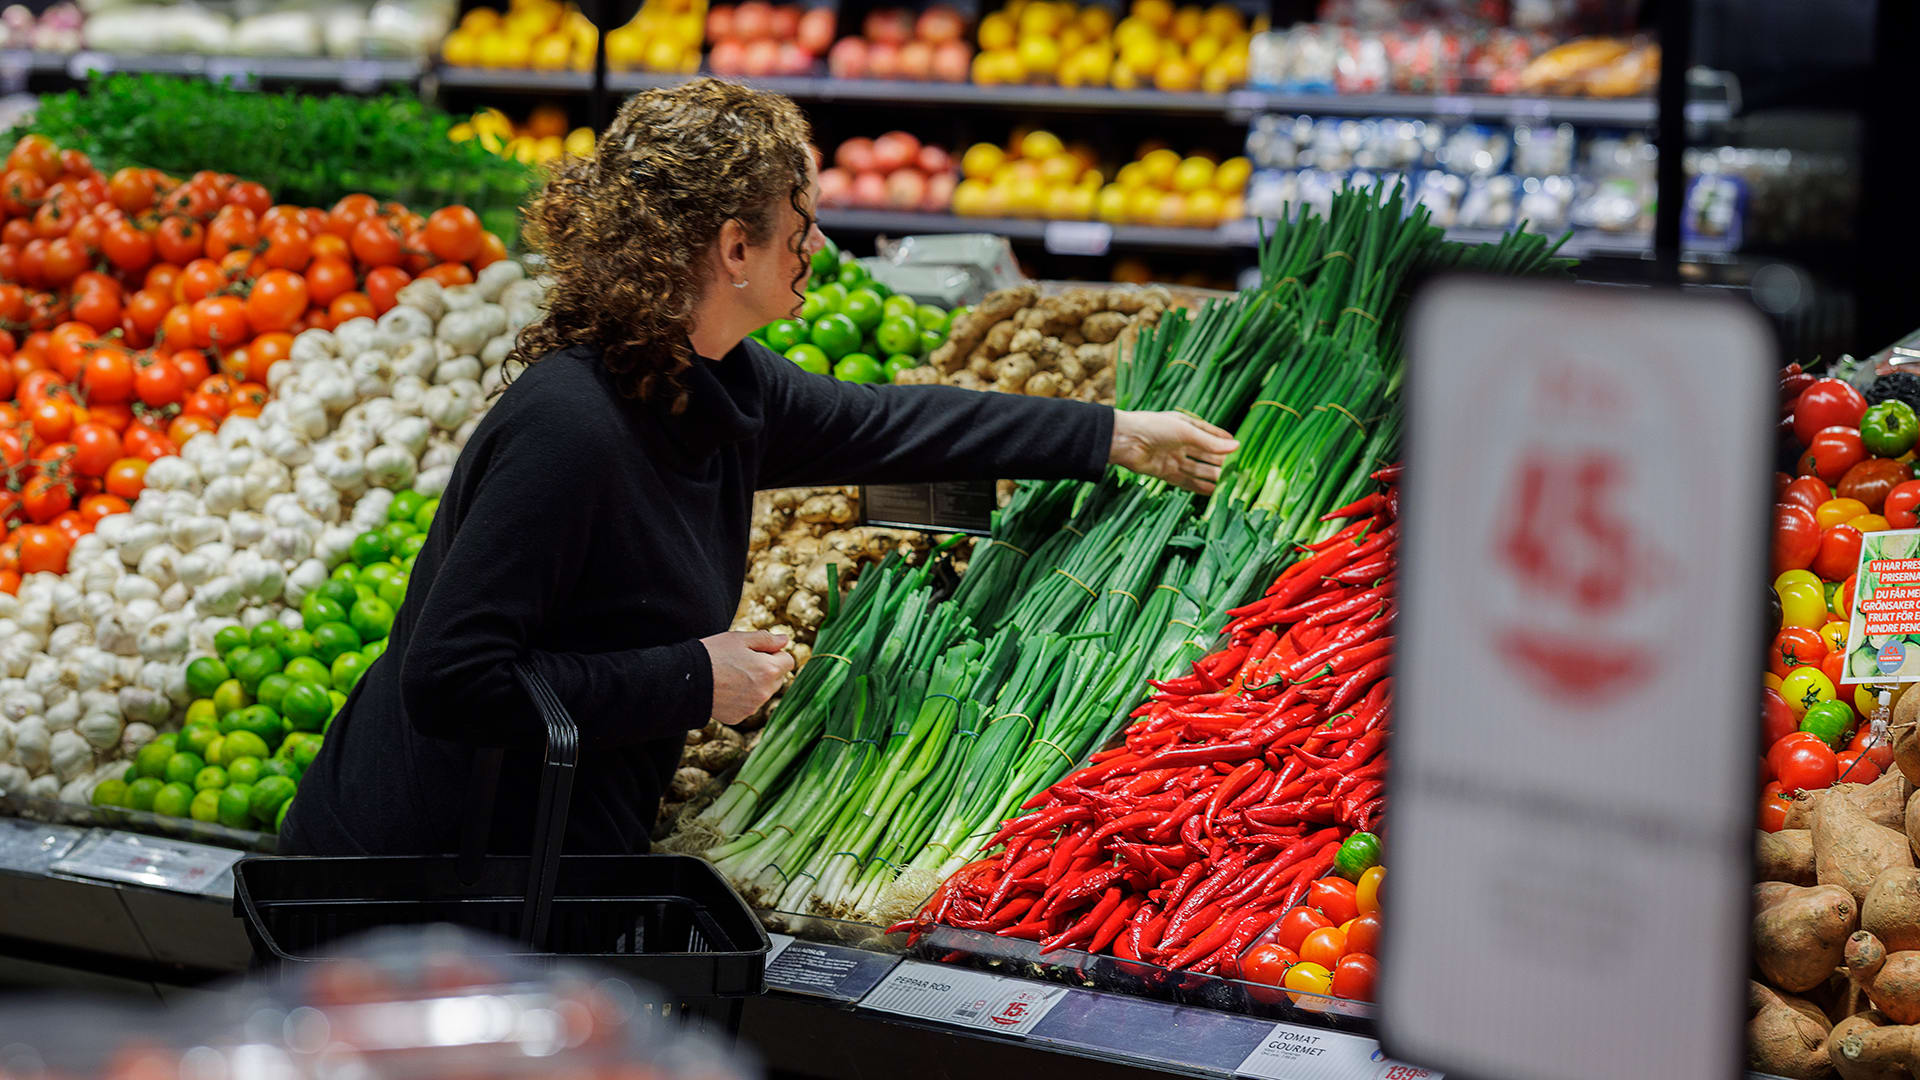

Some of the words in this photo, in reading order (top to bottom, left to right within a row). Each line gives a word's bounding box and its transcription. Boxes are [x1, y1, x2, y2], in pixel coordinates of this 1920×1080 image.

[1872, 562, 1882, 571] VI
[1882, 561, 1901, 571] HAR
[1875, 590, 1889, 599] DU
[1889, 587, 1906, 599] FÅR
[1863, 600, 1915, 611] GRÖNSAKER
[1868, 612, 1896, 622] FRUKT
[1896, 610, 1914, 621] FÖR
[1866, 623, 1899, 633] MINDRE
[894, 975, 929, 988] PEPPAR
[1278, 1031, 1320, 1044] TOMAT
[1268, 1040, 1326, 1057] GOURMET
